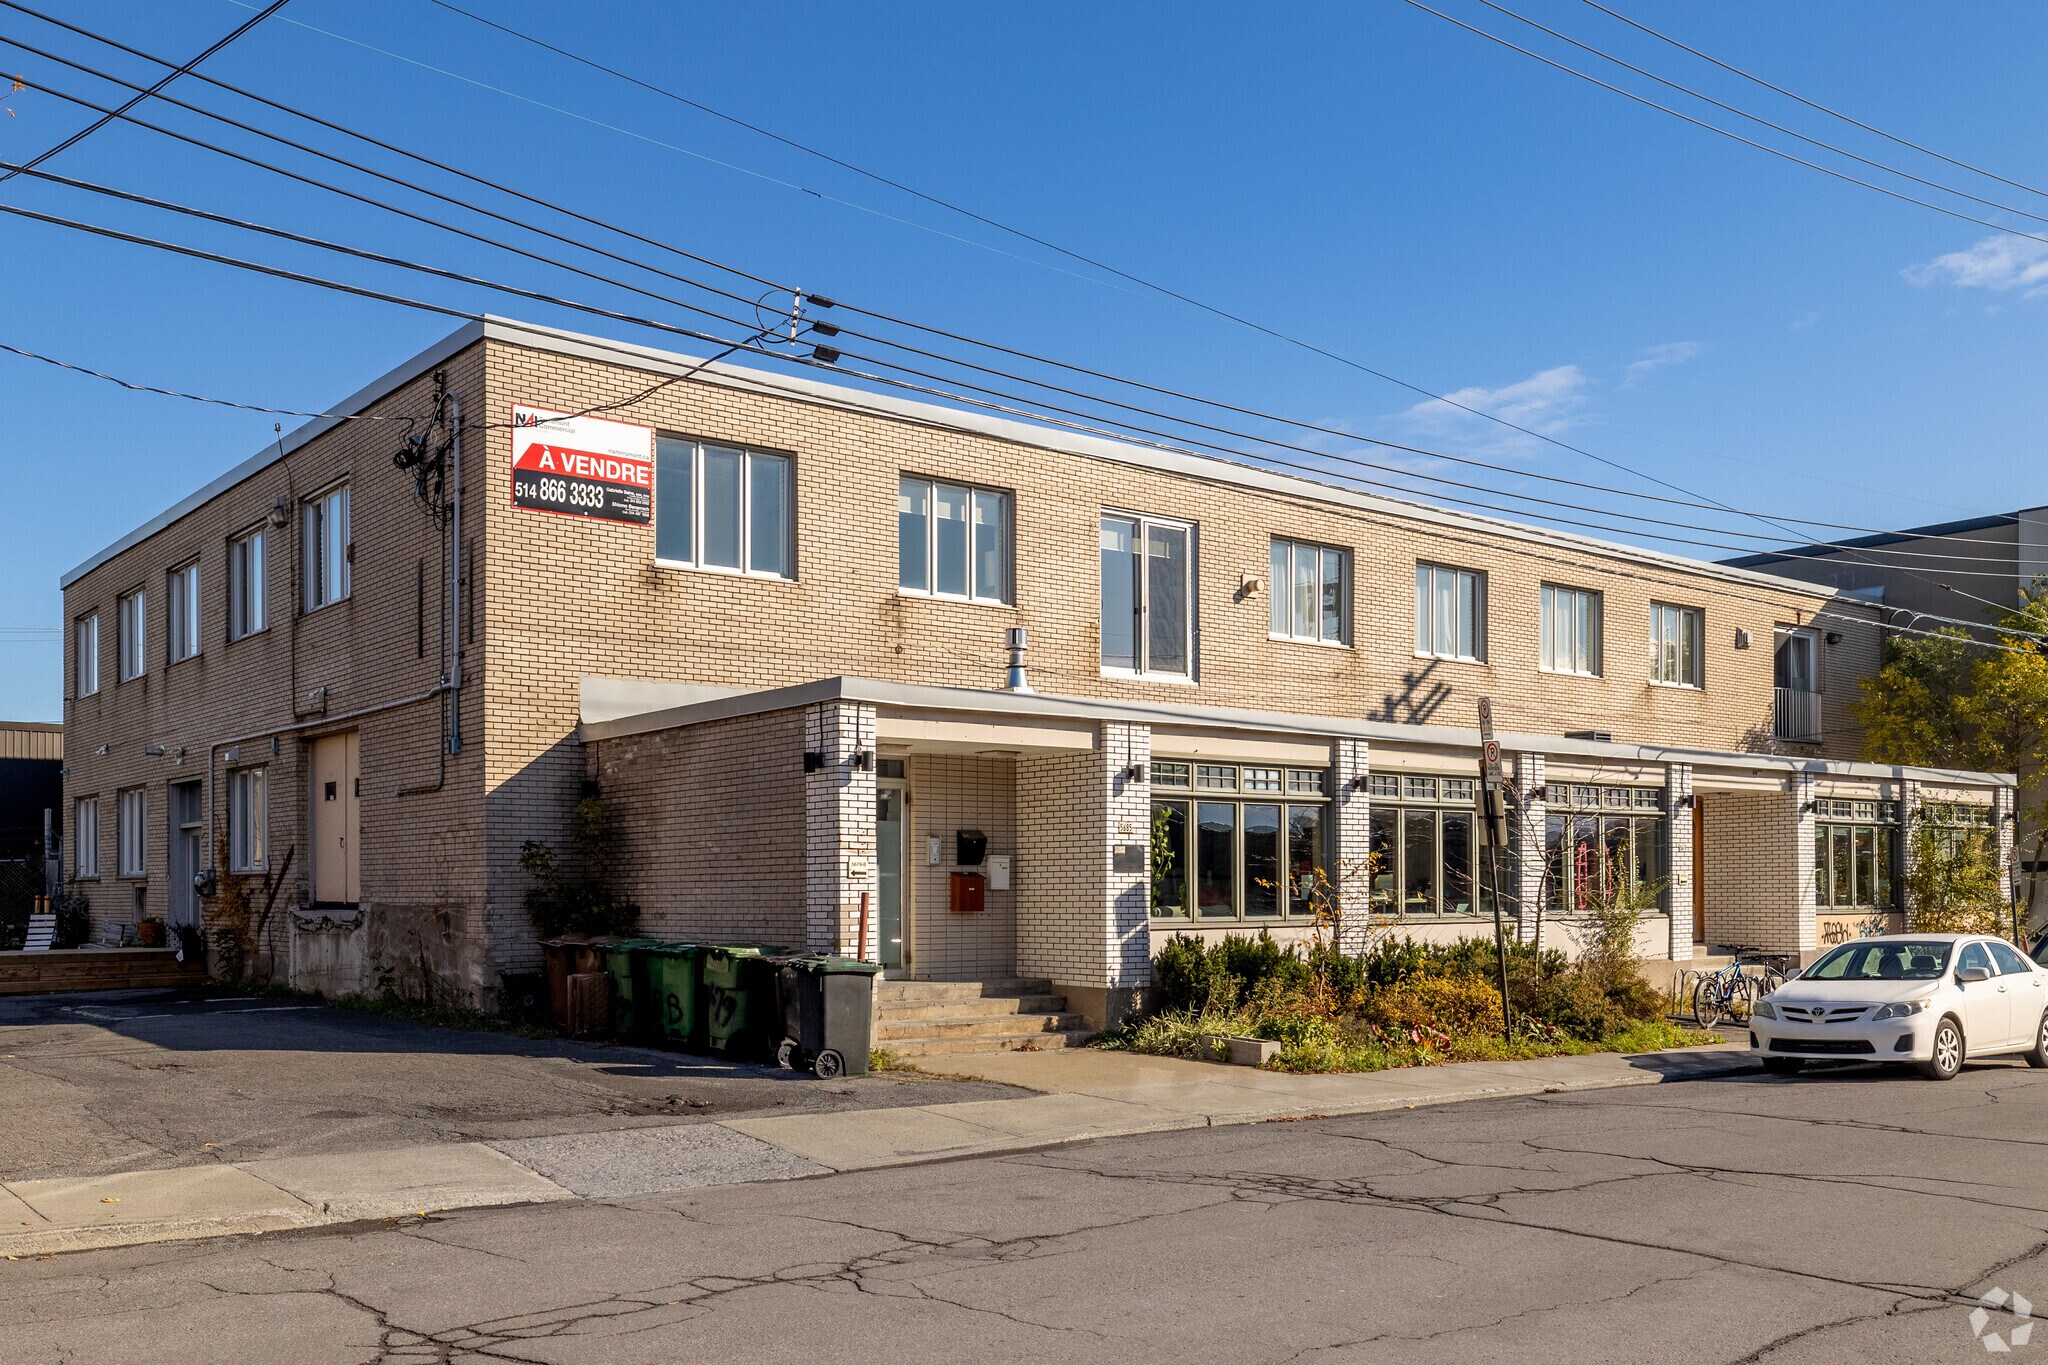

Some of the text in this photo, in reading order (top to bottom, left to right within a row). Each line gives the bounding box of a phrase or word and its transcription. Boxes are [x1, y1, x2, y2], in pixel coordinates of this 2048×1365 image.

[539, 445, 650, 485] À VENDRE
[515, 482, 538, 499] 514
[540, 477, 567, 503] 866
[570, 482, 604, 508] 3333
[1120, 823, 1132, 832] 5685
